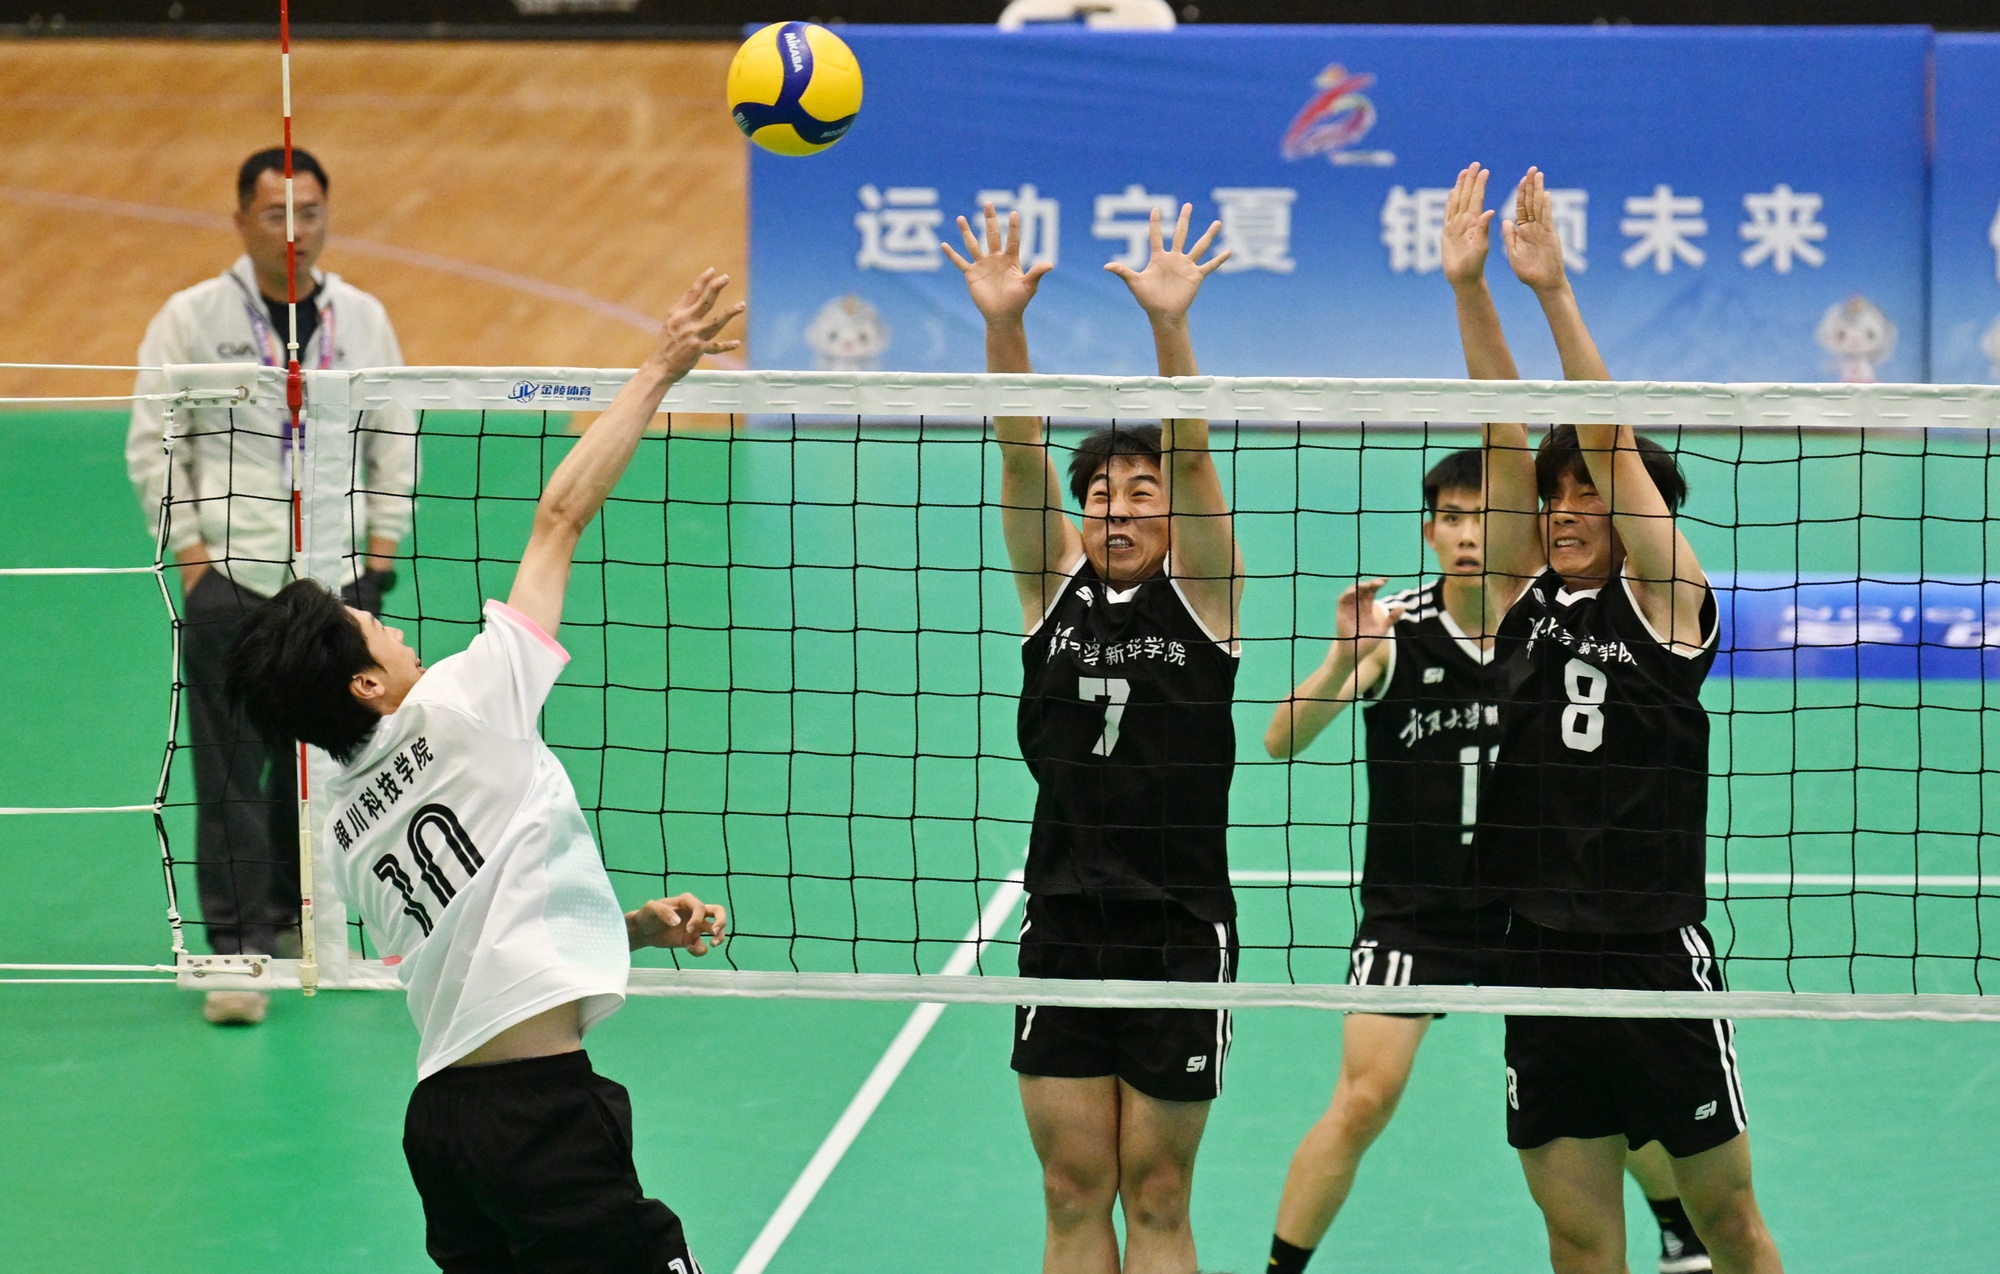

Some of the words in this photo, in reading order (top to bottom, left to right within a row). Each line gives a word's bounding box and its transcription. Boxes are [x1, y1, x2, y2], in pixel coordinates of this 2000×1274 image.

[541, 385, 592, 396] 金陵体育
[1078, 676, 1131, 757] 7
[1561, 657, 1608, 752] 8
[333, 737, 433, 852] 银川科技学院
[1459, 744, 1500, 845] 1
[372, 803, 485, 938] 10
[1507, 1066, 1520, 1110] 8
